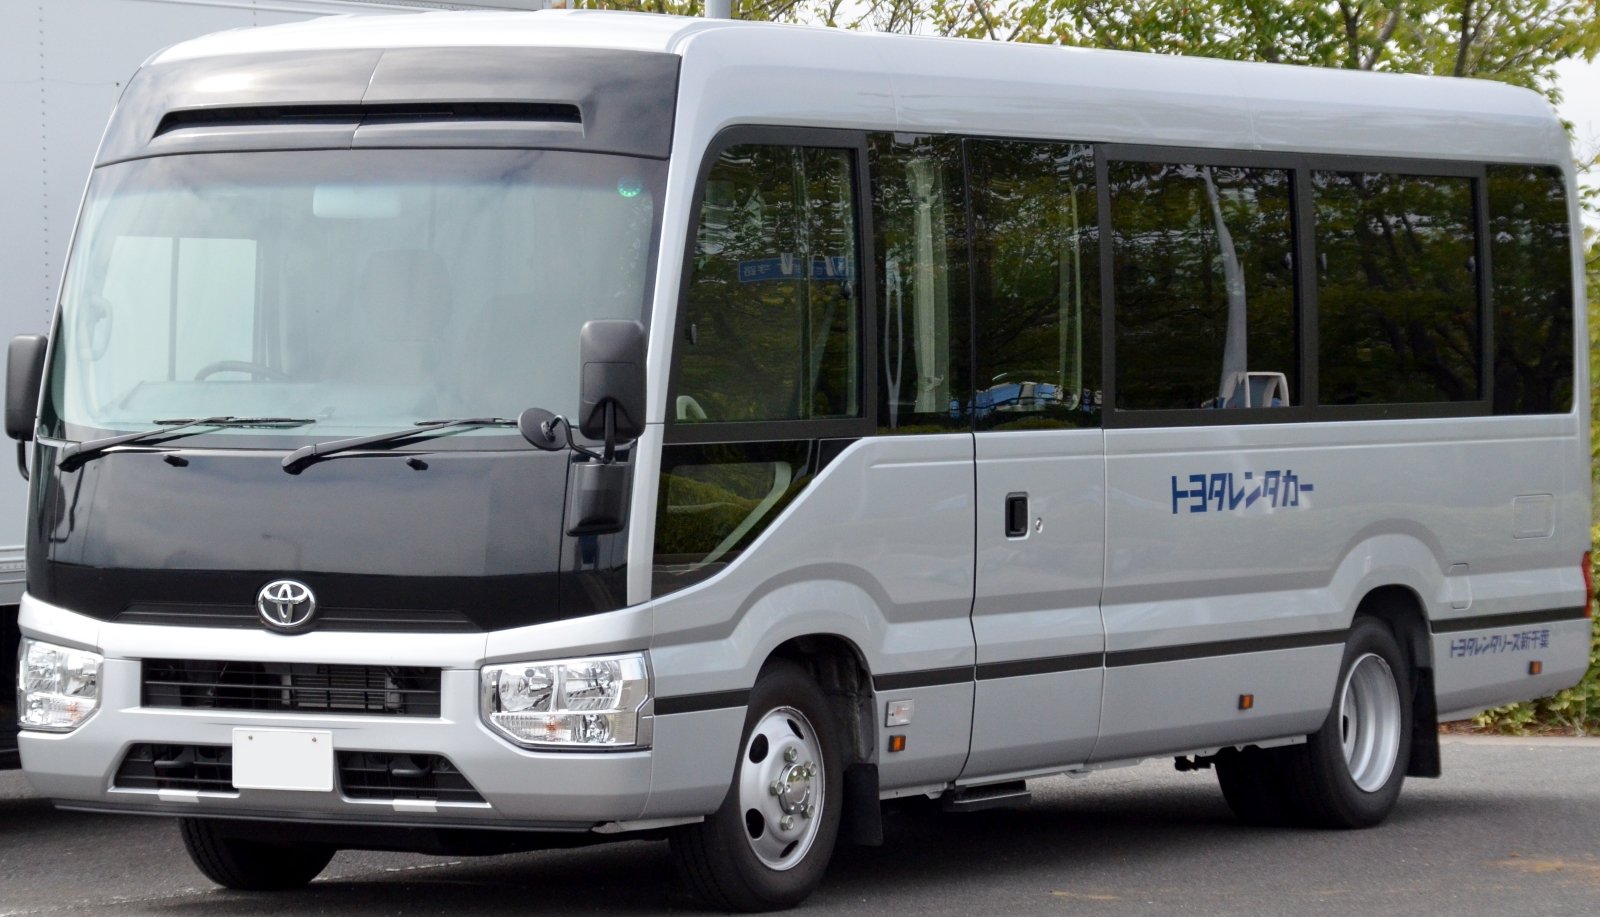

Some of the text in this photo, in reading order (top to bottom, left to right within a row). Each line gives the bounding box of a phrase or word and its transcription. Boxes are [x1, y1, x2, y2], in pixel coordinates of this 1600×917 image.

[1172, 470, 1313, 514] トヨタレンタカー
[1450, 629, 1550, 658] トヨタレンタリース新千葉
